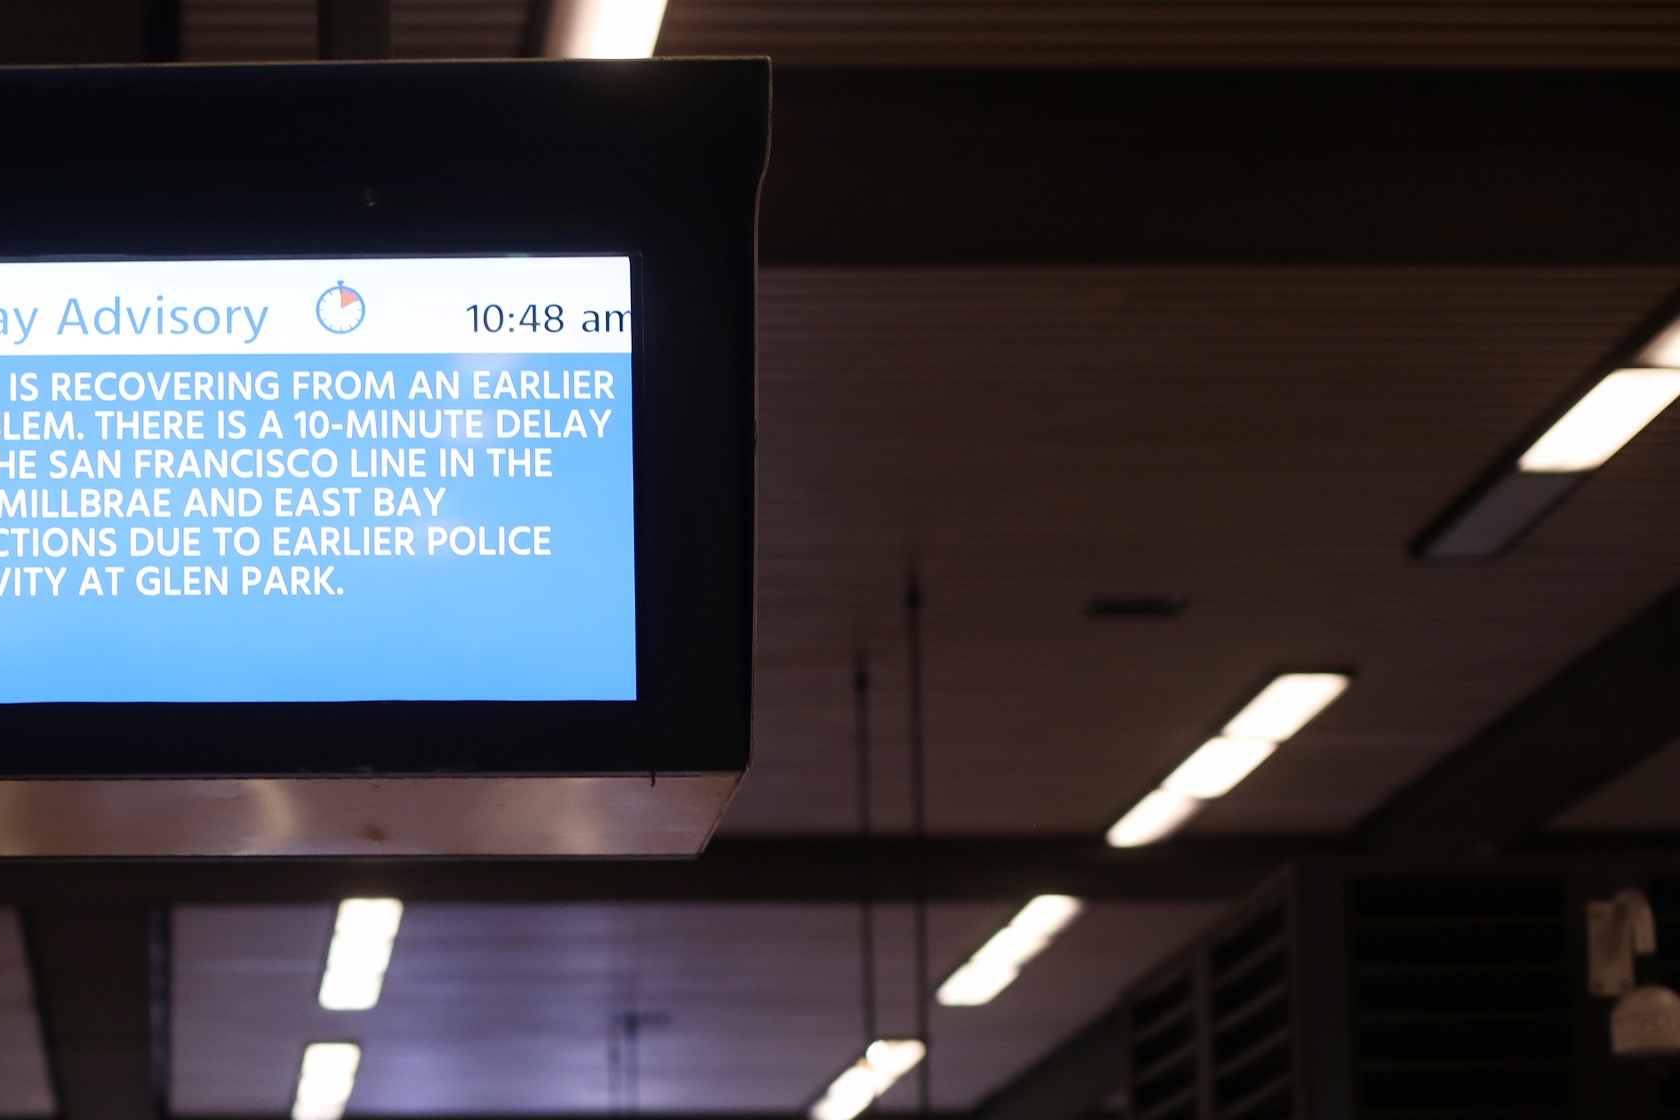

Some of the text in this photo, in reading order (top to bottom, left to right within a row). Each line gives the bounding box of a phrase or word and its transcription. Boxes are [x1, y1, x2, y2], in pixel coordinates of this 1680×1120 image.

[57, 295, 268, 343] Advisory
[467, 304, 564, 333] 10:48
[11, 373, 38, 401] IS
[52, 371, 279, 401] RECOVERING
[294, 371, 395, 399] FROM
[409, 371, 459, 399] AN
[473, 370, 614, 399] EARLIER
[95, 410, 204, 439] THERE
[218, 410, 246, 439] IS
[259, 410, 283, 438] A
[294, 409, 483, 439] 10-MINUTE
[497, 409, 611, 438] DELAY
[50, 450, 121, 479] SAN
[135, 448, 338, 478] FRANCISCO
[351, 448, 426, 477] LINE
[440, 448, 474, 477] IN
[486, 448, 552, 477] THE
[184, 488, 262, 517] AND
[276, 488, 362, 516] EAST
[374, 488, 446, 516] BAY
[131, 527, 200, 556] DUE
[213, 527, 260, 556] TO
[274, 527, 415, 555] EARLIER
[428, 526, 551, 555] POLICE
[79, 567, 124, 595] AT
[136, 566, 228, 595] GLEN
[242, 566, 343, 595] PARK.
